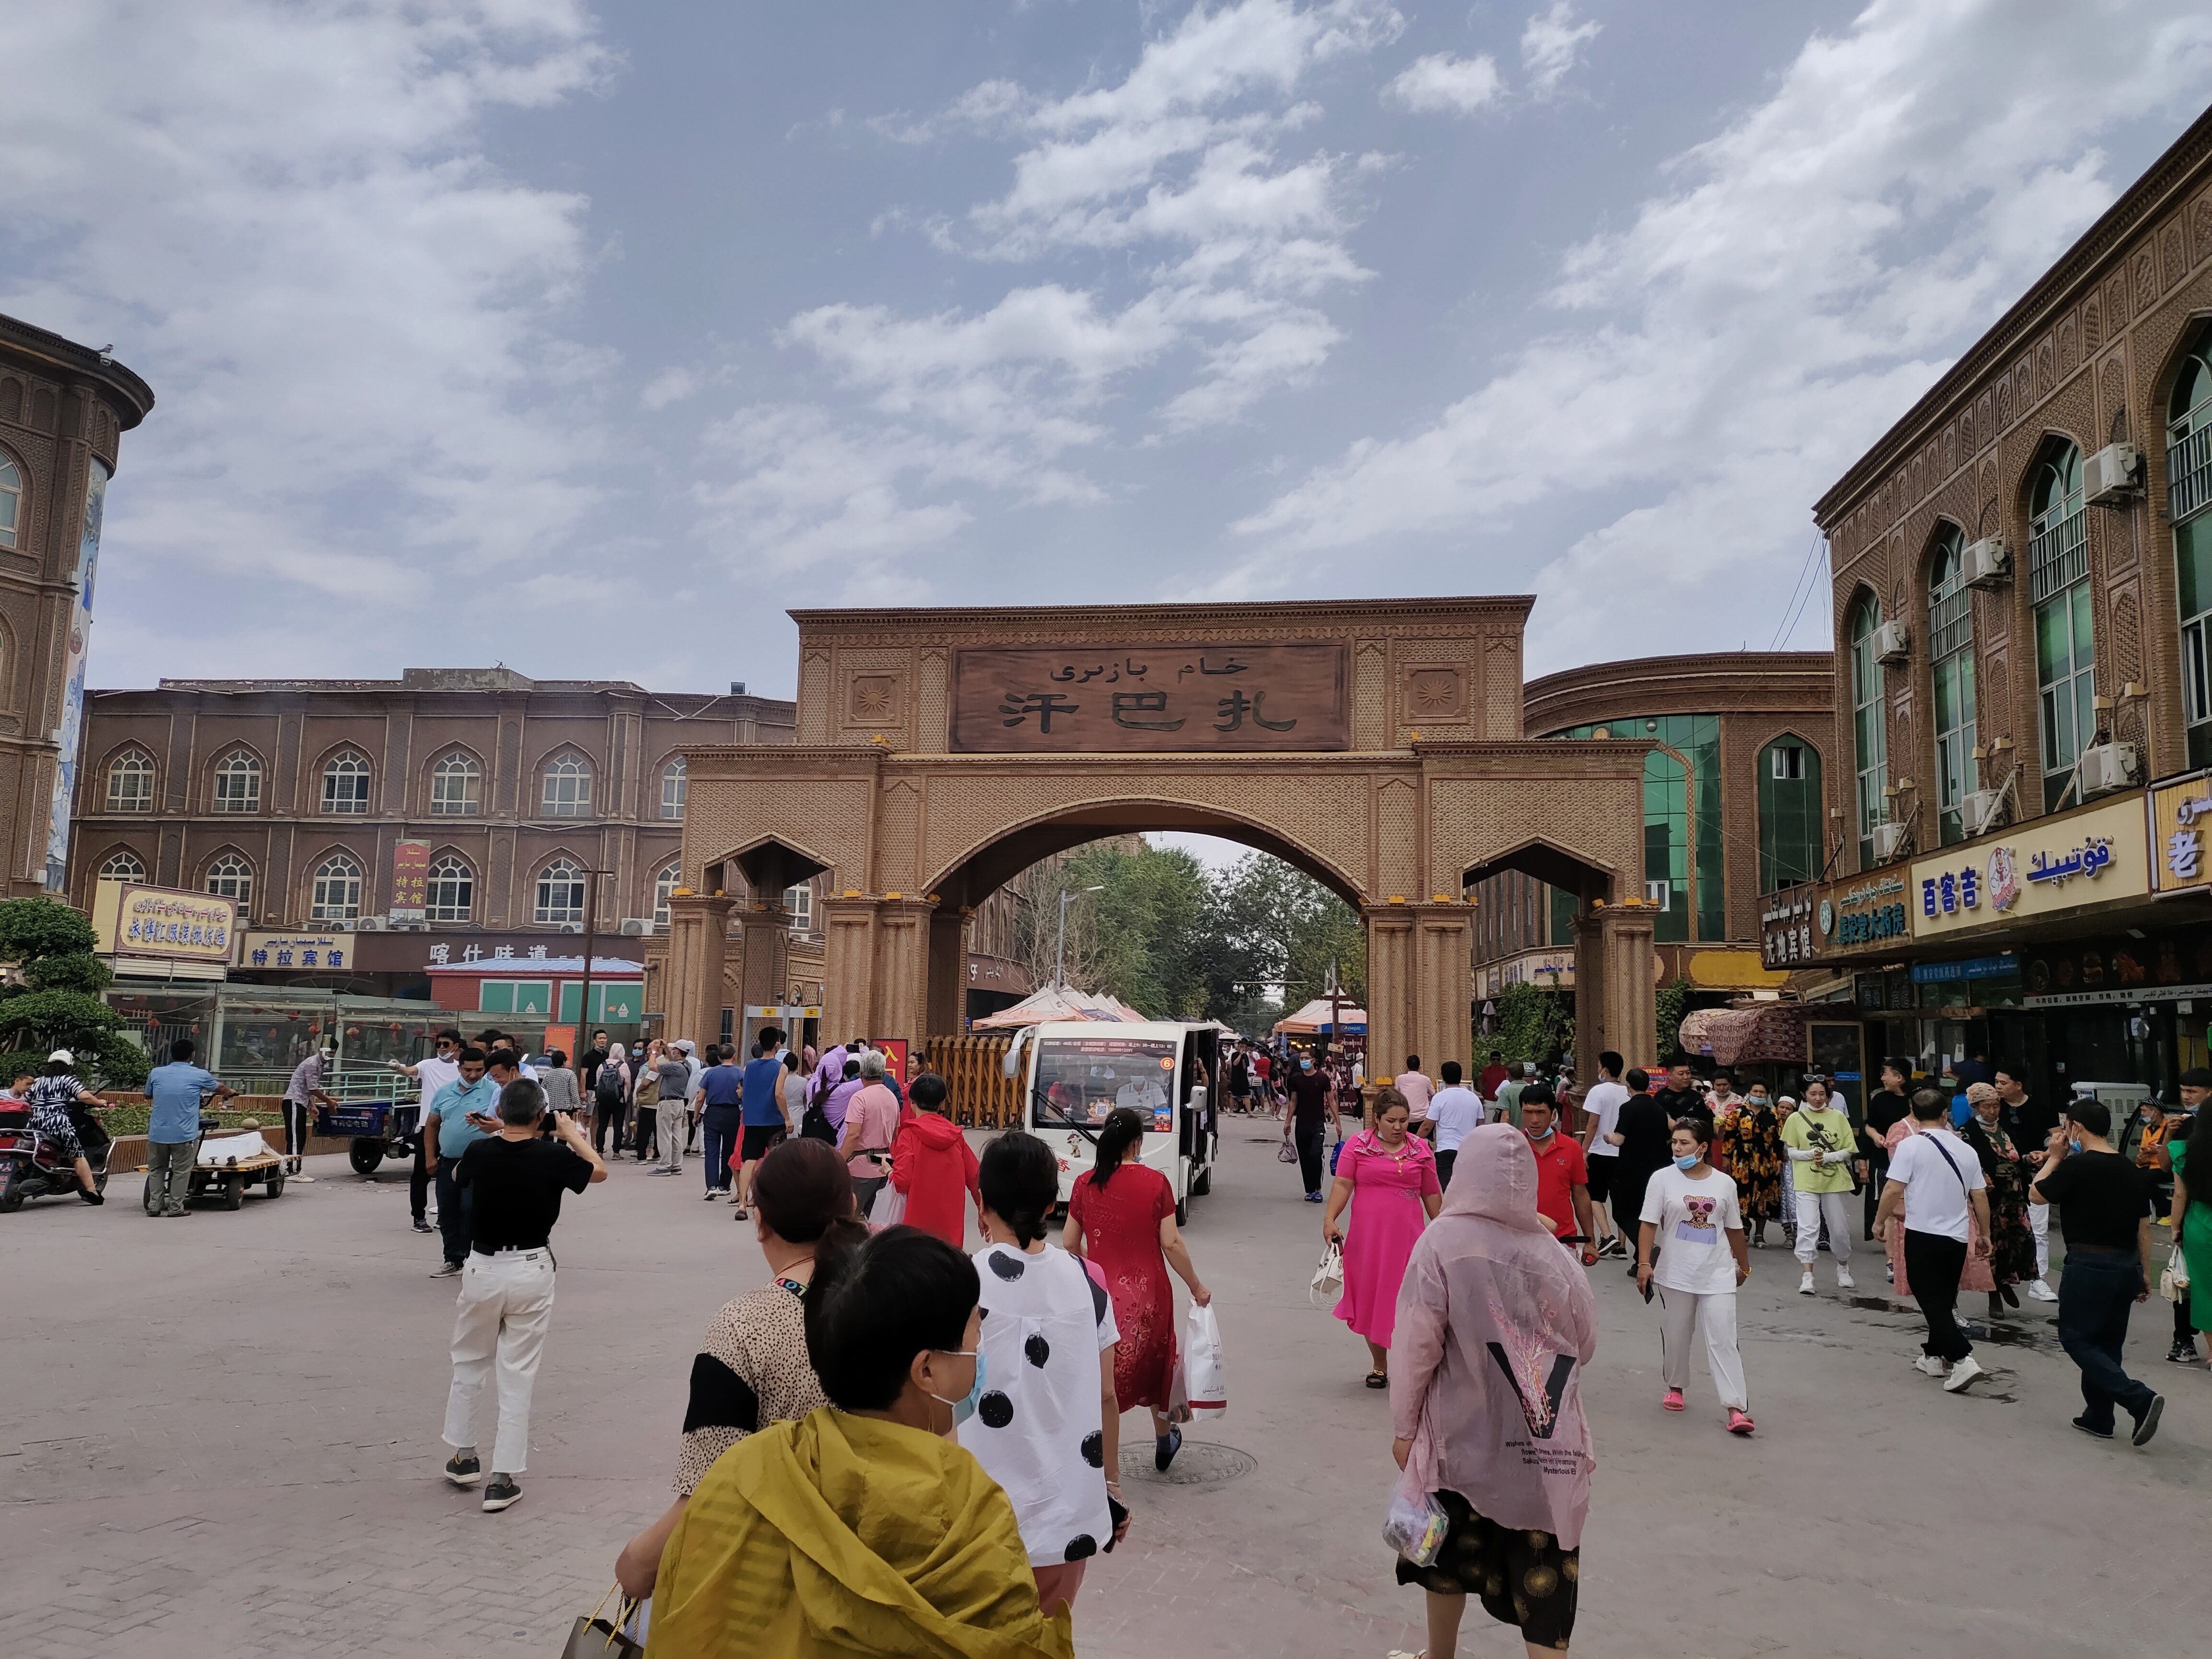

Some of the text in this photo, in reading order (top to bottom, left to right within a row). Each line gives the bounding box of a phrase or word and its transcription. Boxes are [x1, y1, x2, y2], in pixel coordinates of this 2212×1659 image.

[998, 690, 1298, 734] 汗巴扎
[2167, 831, 2198, 878] 老
[394, 890, 423, 905] 宾馆
[396, 876, 424, 888] 特拉
[1922, 866, 1976, 916] 百客吉
[252, 949, 343, 967] 特拉宾馆
[1765, 924, 1811, 964] 光地宾馆
